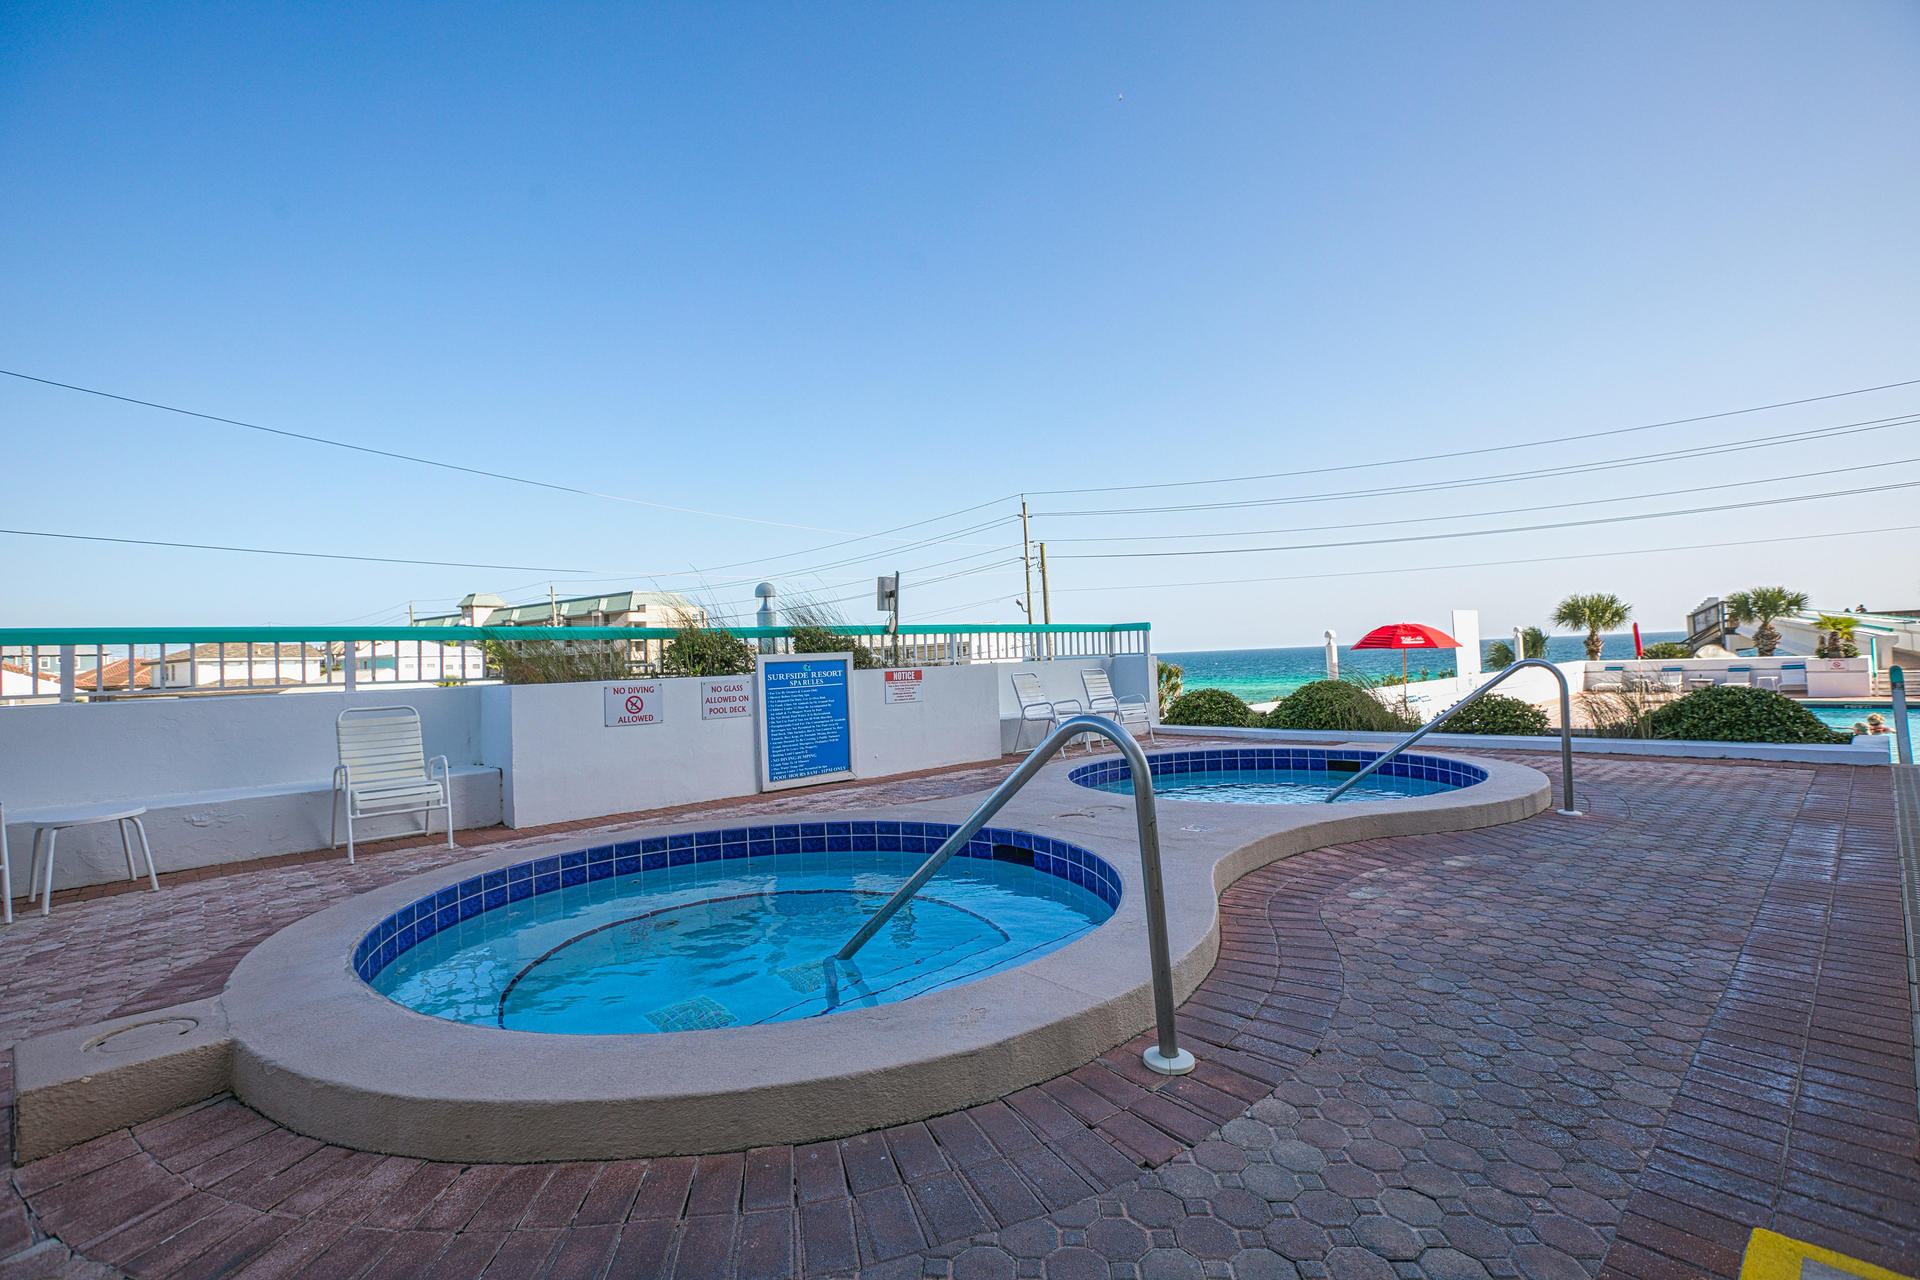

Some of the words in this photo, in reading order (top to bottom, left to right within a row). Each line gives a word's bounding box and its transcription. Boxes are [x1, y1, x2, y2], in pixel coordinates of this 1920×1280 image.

[768, 672, 808, 680] SURFSIDE
[811, 670, 843, 678] RESORT
[893, 671, 915, 680] NOTICE
[628, 686, 654, 694] DIVING
[705, 696, 737, 704] ALLOWED
[618, 714, 654, 724] ALLOWED
